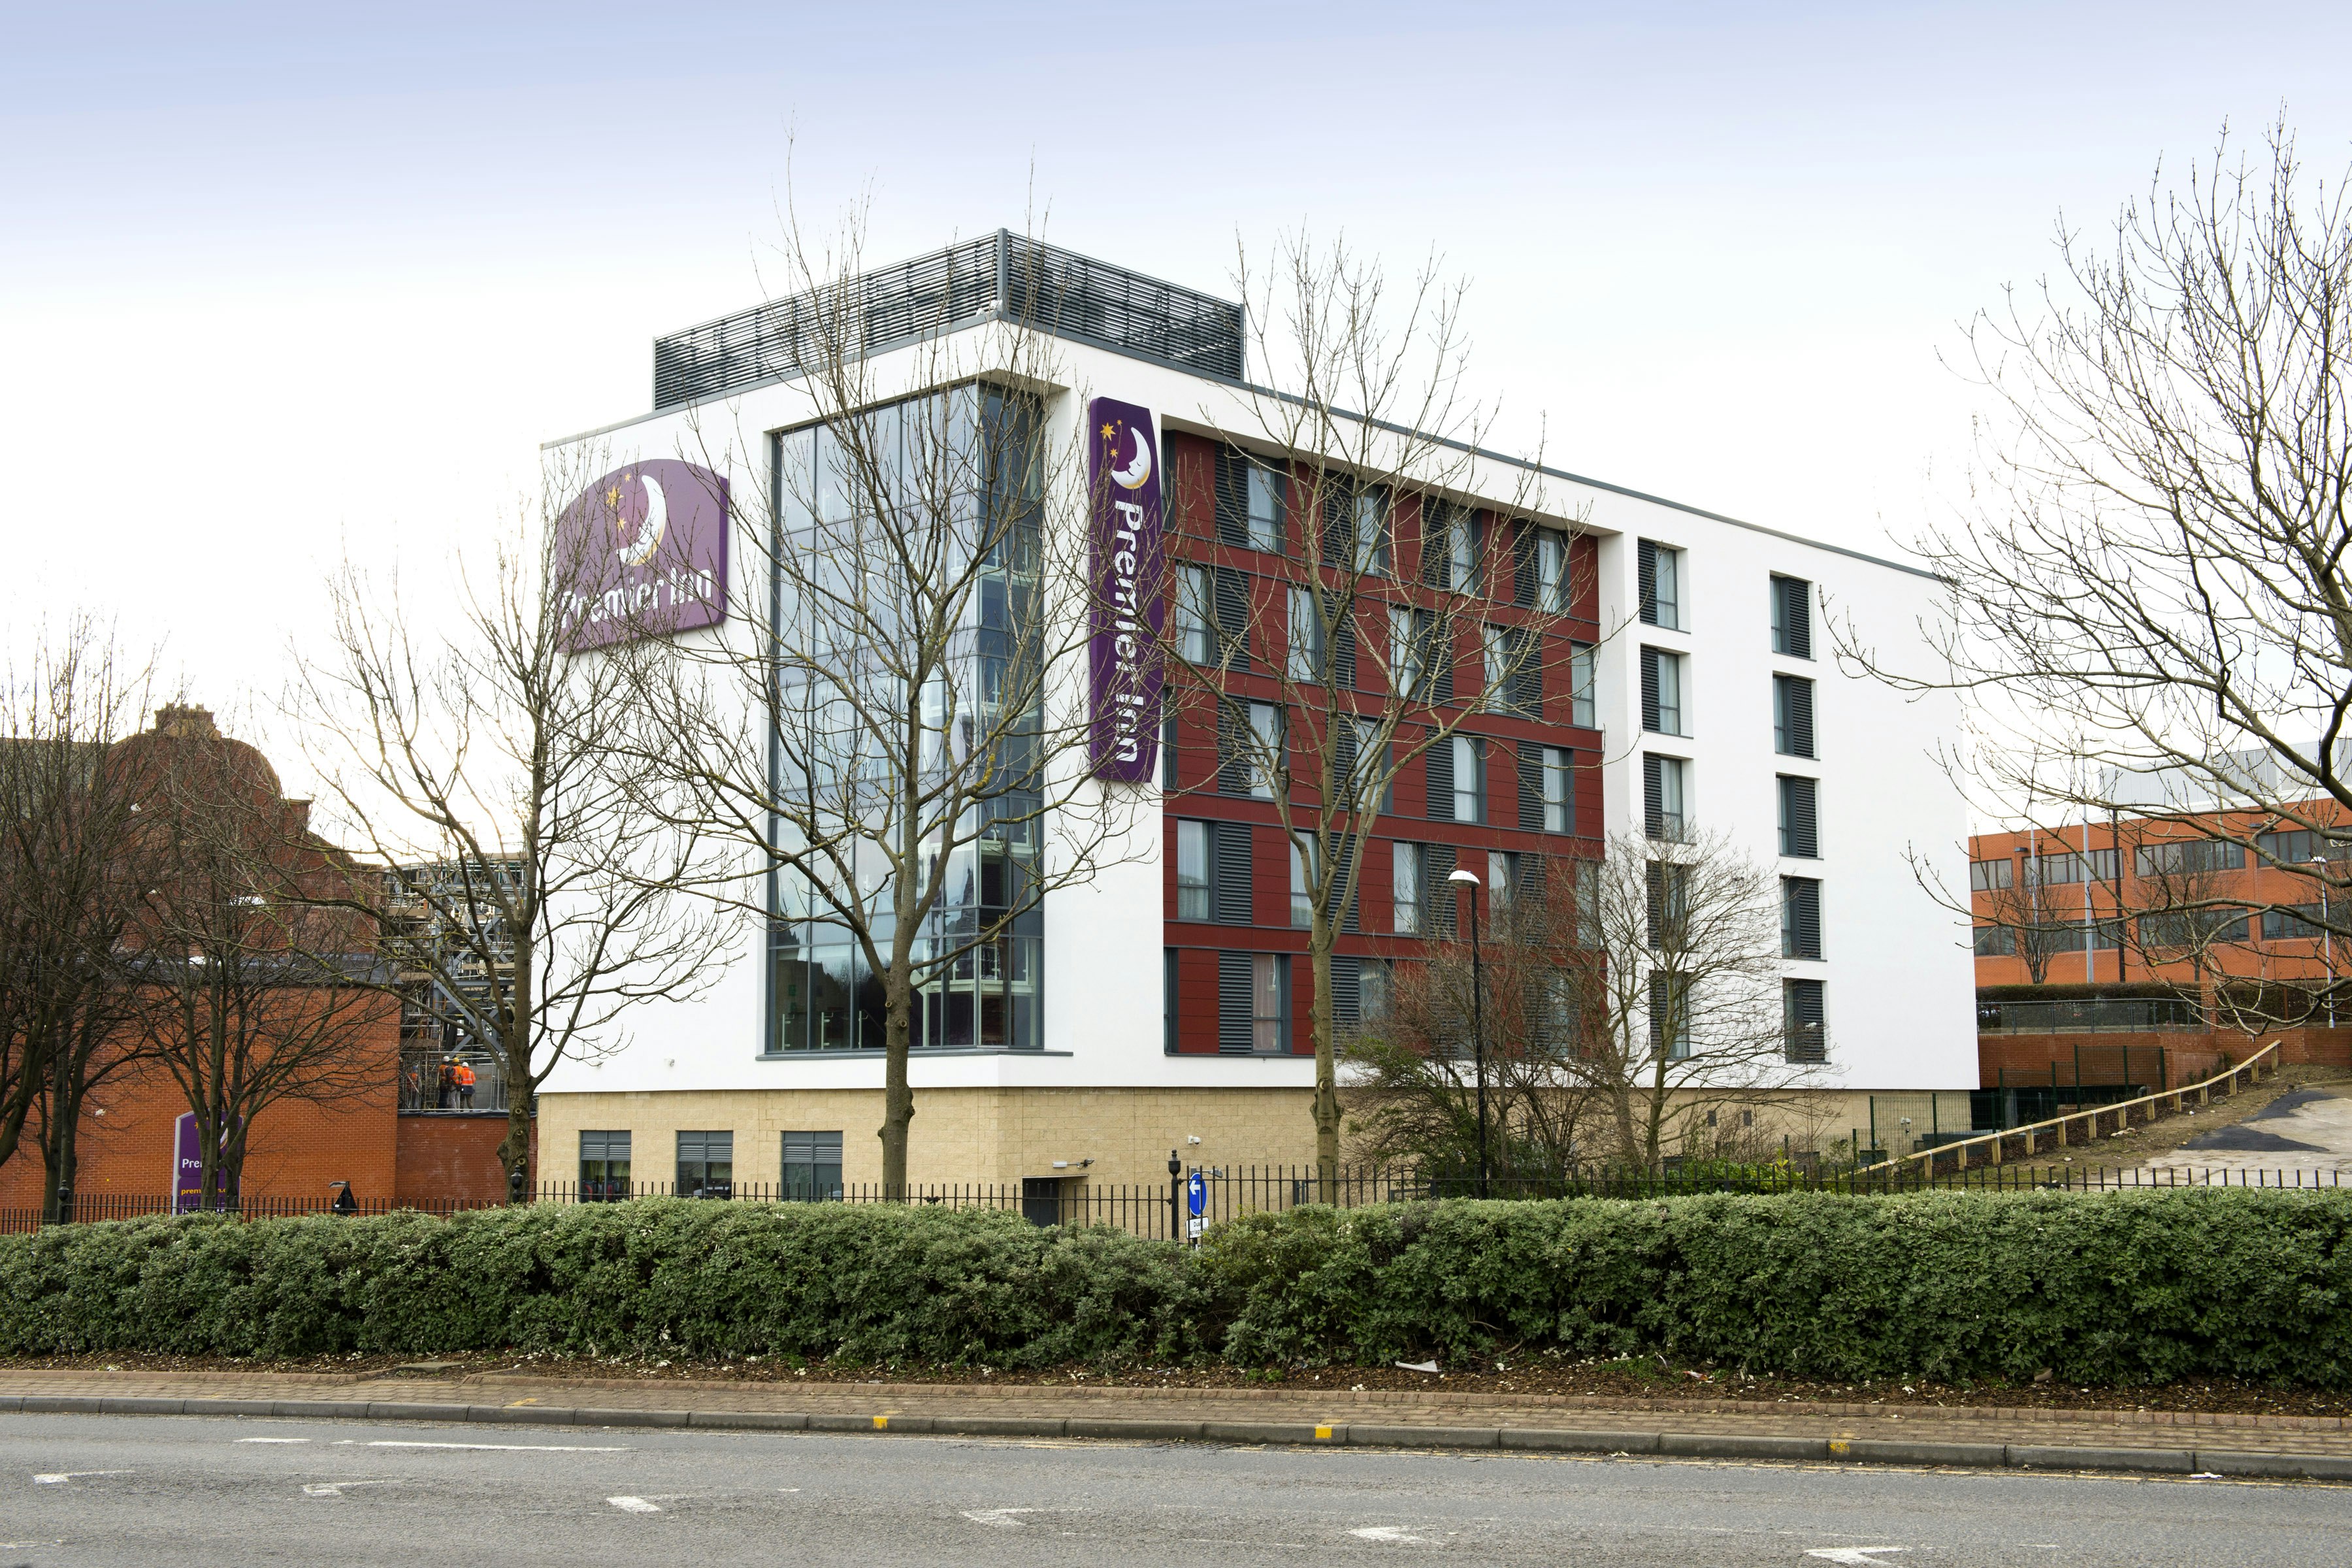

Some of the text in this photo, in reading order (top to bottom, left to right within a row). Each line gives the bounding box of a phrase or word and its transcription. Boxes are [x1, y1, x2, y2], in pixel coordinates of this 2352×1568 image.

[561, 567, 711, 629] Premier Inn
[1115, 500, 1143, 762] Premier Inn
[182, 1158, 203, 1168] Pre
